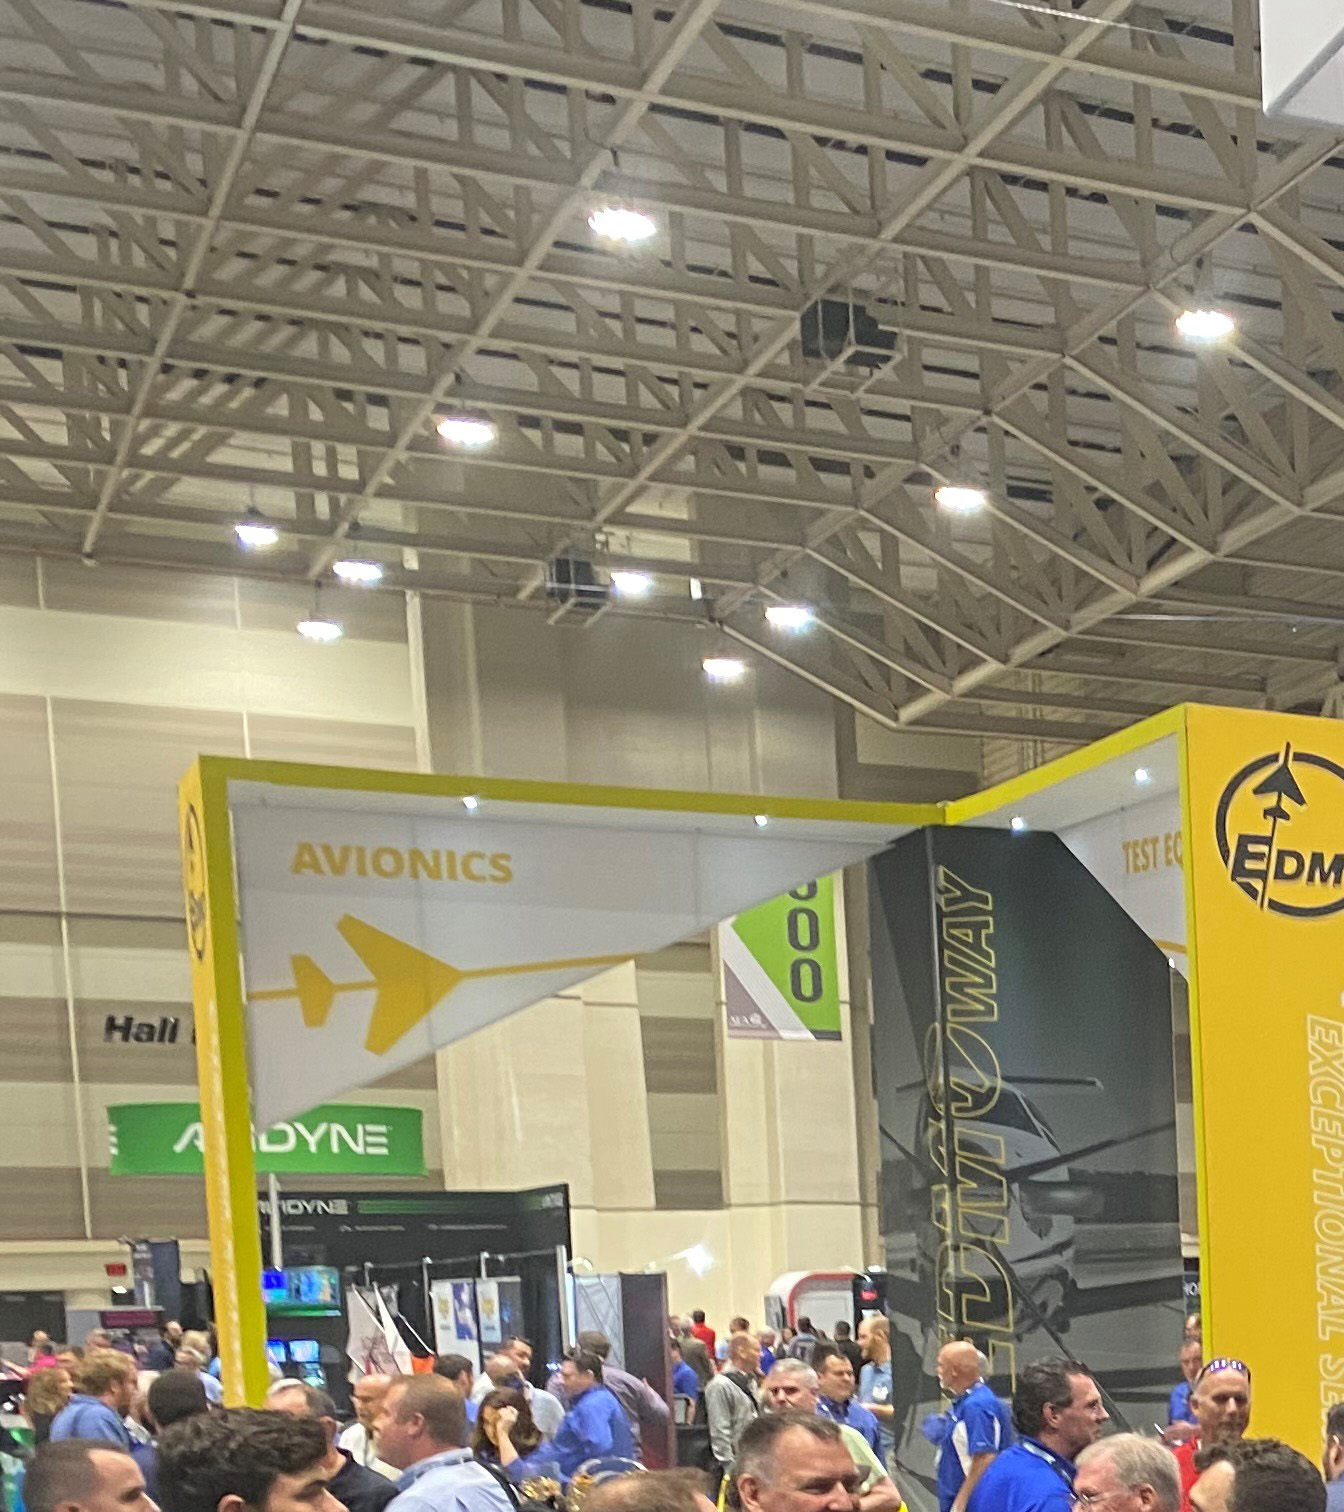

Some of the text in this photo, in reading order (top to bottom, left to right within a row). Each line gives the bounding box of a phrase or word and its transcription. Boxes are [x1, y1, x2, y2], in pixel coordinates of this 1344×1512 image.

[290, 841, 514, 885] AVIONICS
[1121, 836, 1159, 875] TEST
[937, 865, 998, 1023] WAY
[103, 1015, 180, 1044] Hall
[173, 1121, 390, 1156] ADYNE
